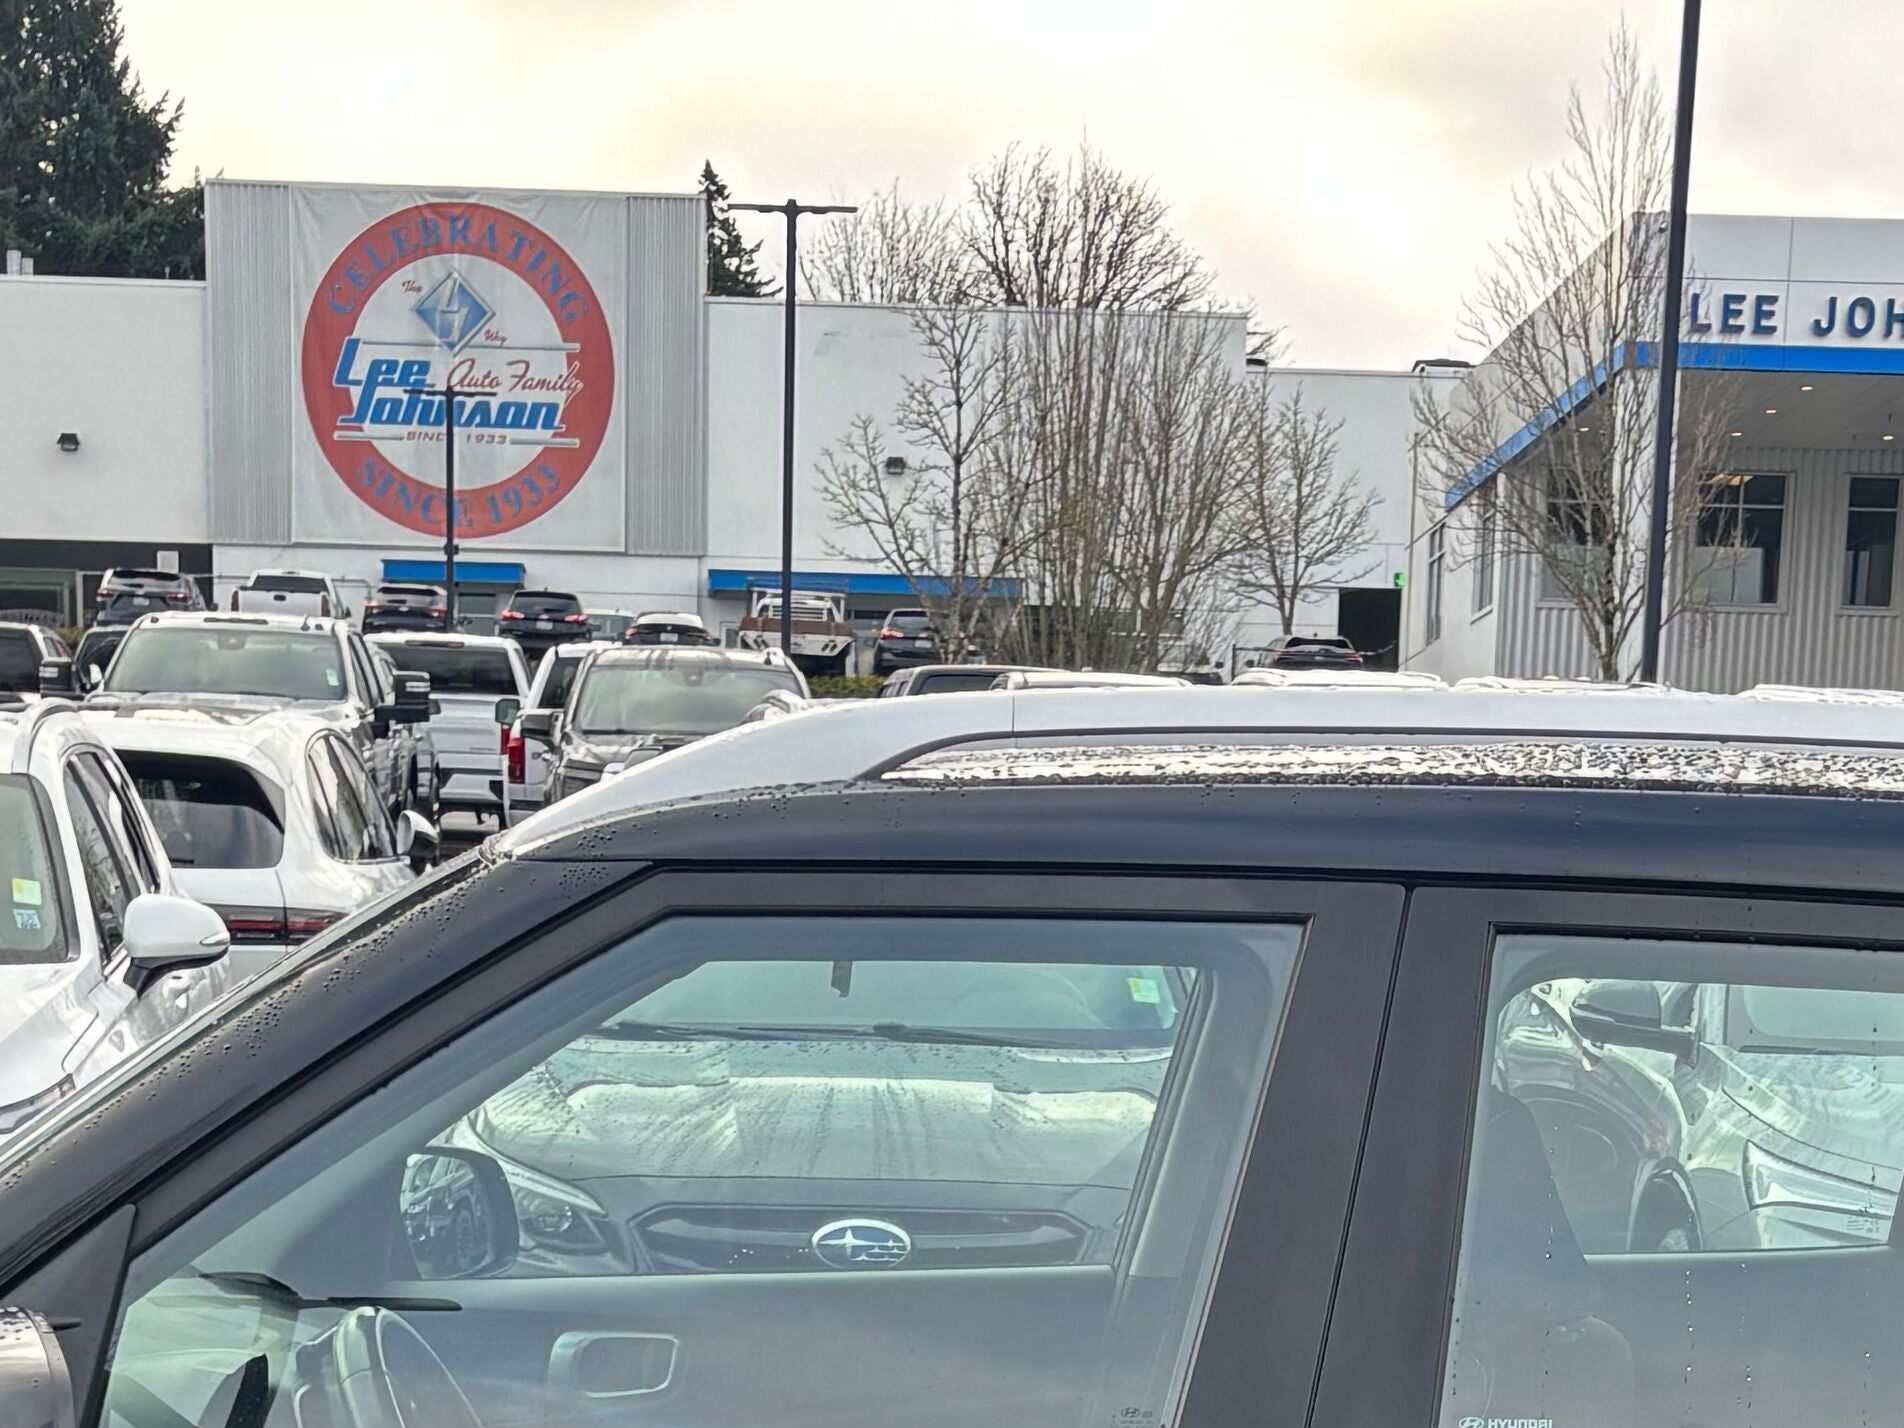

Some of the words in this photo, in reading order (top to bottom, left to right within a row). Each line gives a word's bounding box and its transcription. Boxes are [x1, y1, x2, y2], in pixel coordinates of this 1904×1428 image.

[326, 213, 590, 323] CELEBRATING
[1687, 292, 1780, 336] LEE
[333, 336, 436, 389] Lee
[446, 358, 502, 391] Auto
[506, 359, 584, 405] Family
[337, 386, 566, 431] Johnson
[406, 430, 454, 443] SINC
[465, 432, 508, 446] 1933
[354, 456, 474, 528] SINCE
[484, 462, 562, 523] 1933
